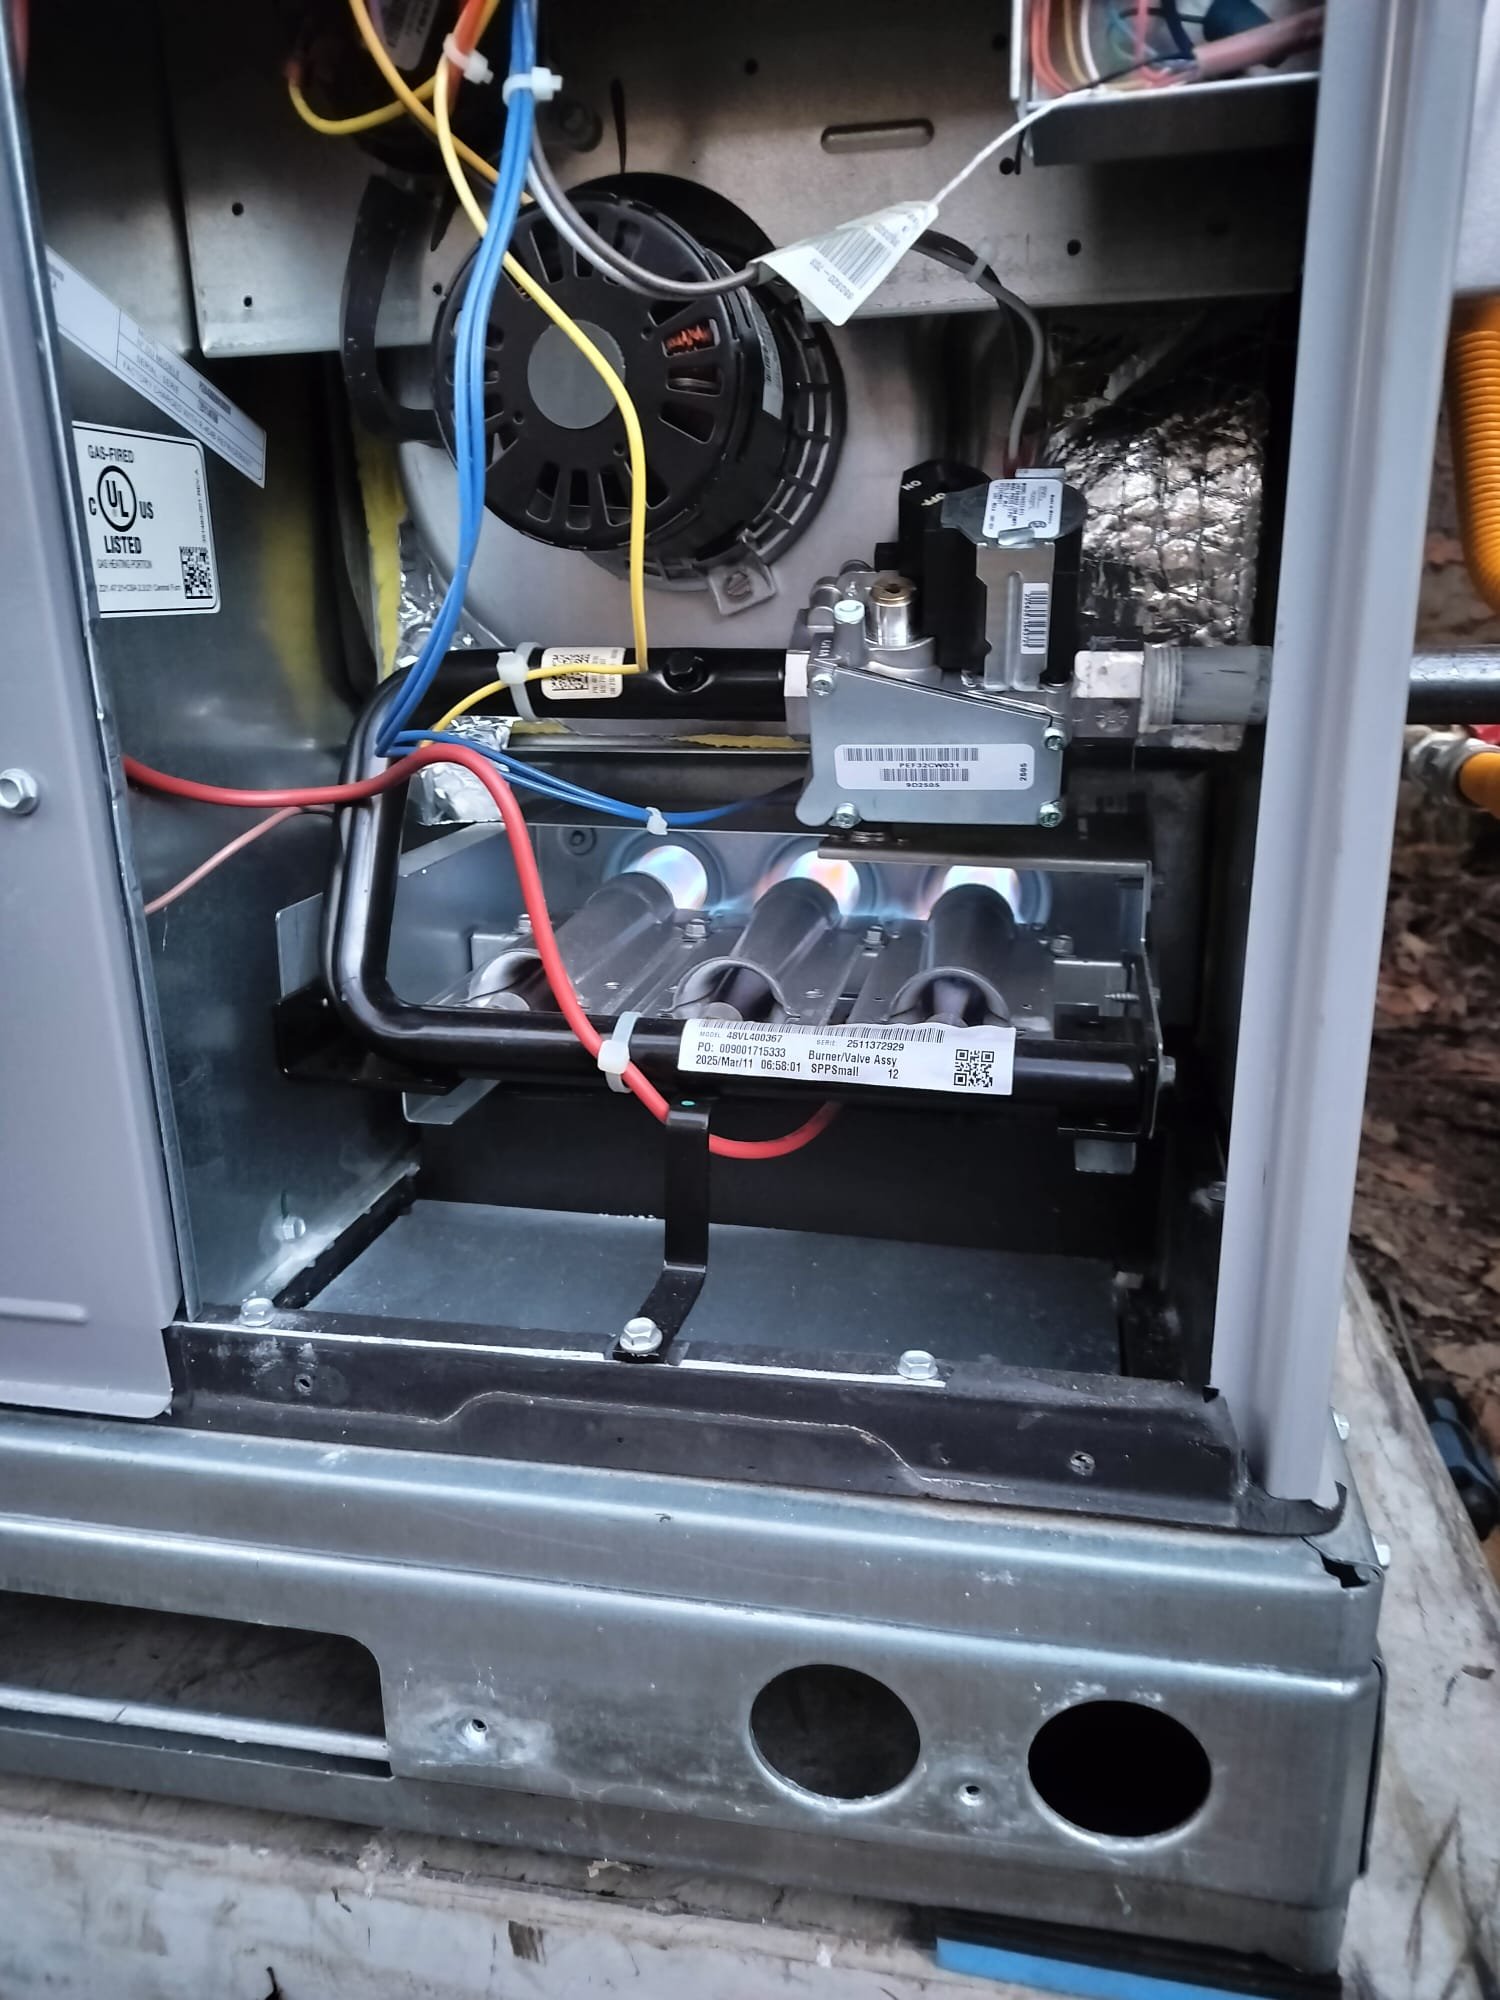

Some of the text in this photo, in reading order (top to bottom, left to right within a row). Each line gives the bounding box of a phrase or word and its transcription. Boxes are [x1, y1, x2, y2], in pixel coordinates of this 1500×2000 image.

[87, 444, 135, 463] GAS-FIRED
[902, 479, 922, 491] ON
[88, 480, 155, 519] C UL US
[104, 535, 143, 554] LISTED
[726, 1031, 783, 1043] 48VL400367
[846, 1039, 904, 1051] 2511372929
[697, 1041, 898, 1068] PO: 009001715333 Burner/Valve Assy
[695, 1054, 899, 1079] 2025/Mar/11 06:58:01 SPPSmall 12
